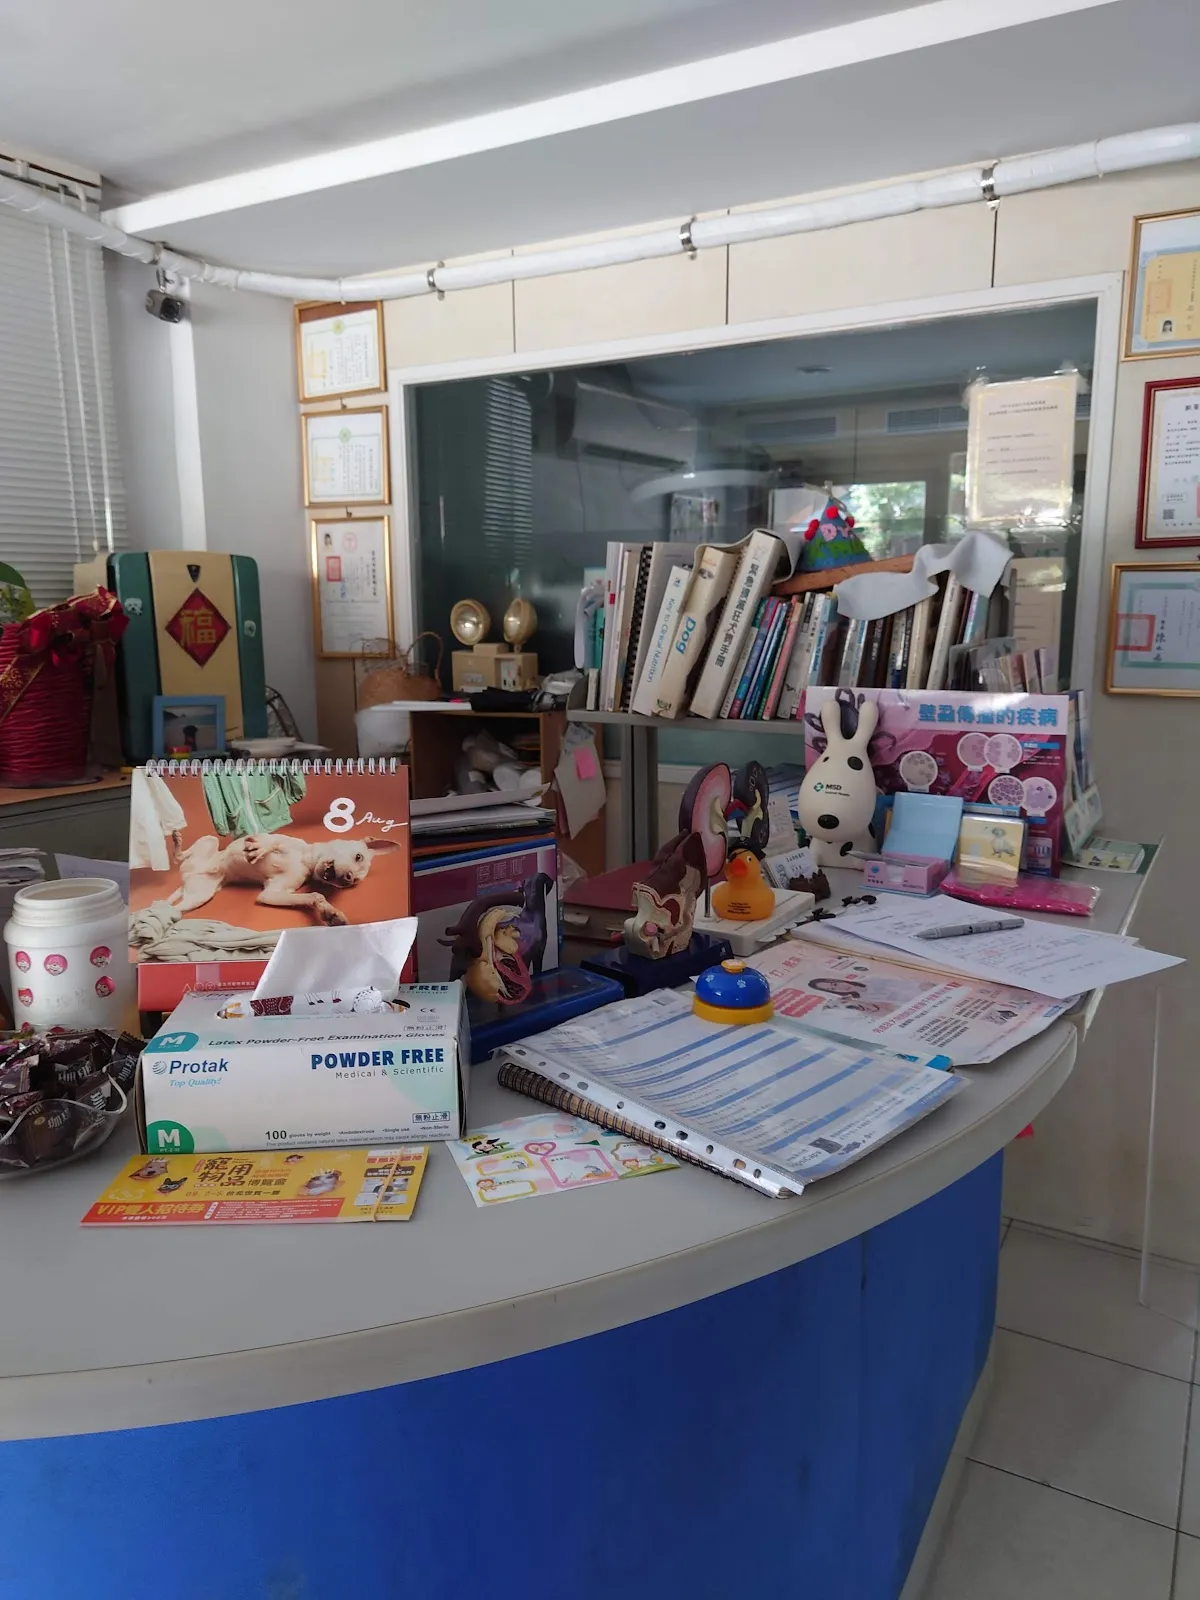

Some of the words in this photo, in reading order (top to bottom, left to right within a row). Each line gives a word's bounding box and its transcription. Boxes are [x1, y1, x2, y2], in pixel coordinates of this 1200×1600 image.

[181, 607, 216, 648] 福
[676, 616, 696, 654] Dog
[323, 797, 355, 833] 8
[356, 811, 408, 832] Aug
[160, 1034, 187, 1045] M
[246, 1035, 324, 1045] Powder-Free
[327, 1033, 402, 1041] Examination
[169, 1058, 229, 1074] Protak
[311, 1050, 394, 1070] POWDER
[401, 1048, 444, 1064] FREE
[335, 1069, 376, 1079] Medical
[393, 1065, 444, 1076] Scientific
[169, 1080, 186, 1088] Top
[415, 1112, 448, 1121] 無粉止滑
[158, 1128, 180, 1147] M
[265, 1130, 287, 1140] 100
